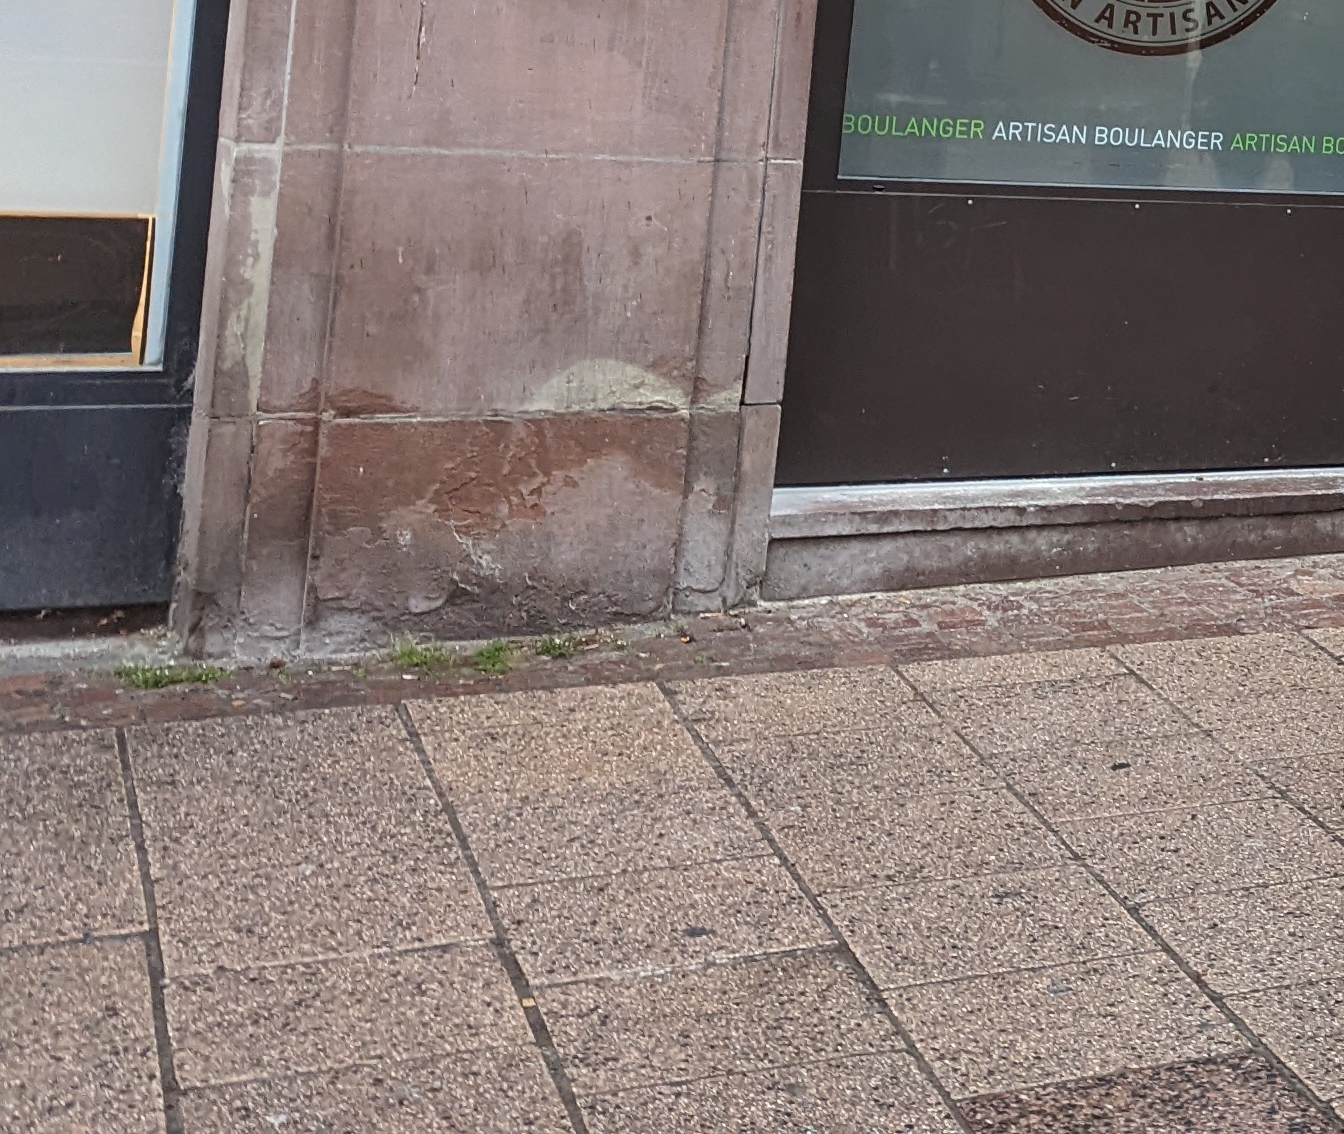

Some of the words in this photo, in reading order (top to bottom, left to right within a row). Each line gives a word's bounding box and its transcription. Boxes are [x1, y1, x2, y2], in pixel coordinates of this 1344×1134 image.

[842, 113, 985, 140] BOULANGER
[991, 120, 1087, 145] ARTISAN
[1093, 126, 1224, 152] BOULANGER
[1230, 132, 1316, 155] ARTISAN
